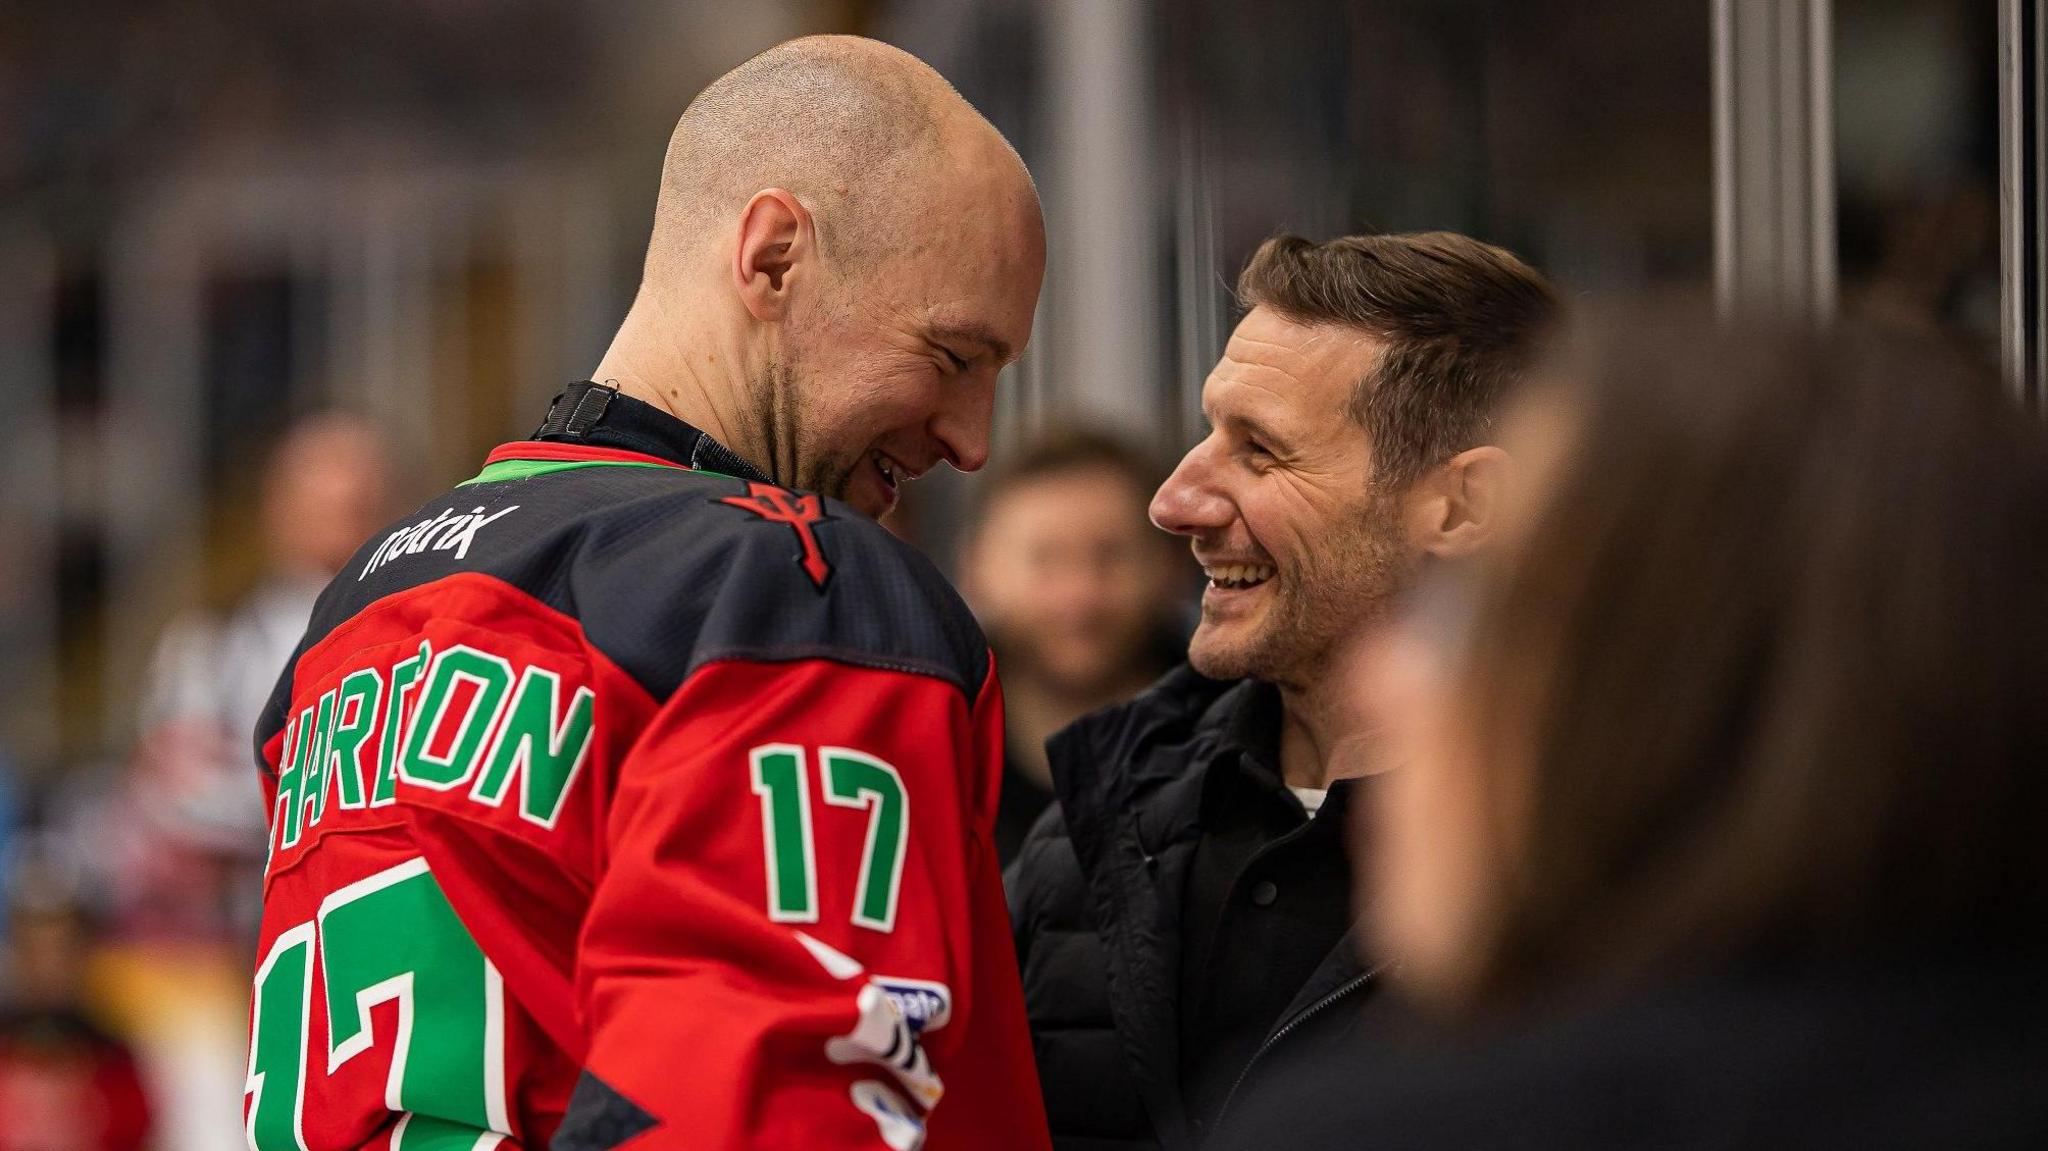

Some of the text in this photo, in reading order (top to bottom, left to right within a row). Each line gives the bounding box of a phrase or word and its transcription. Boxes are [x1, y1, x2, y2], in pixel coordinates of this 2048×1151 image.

[358, 506, 520, 581] matrix
[749, 743, 910, 933] 17
[244, 856, 512, 1151] 17
